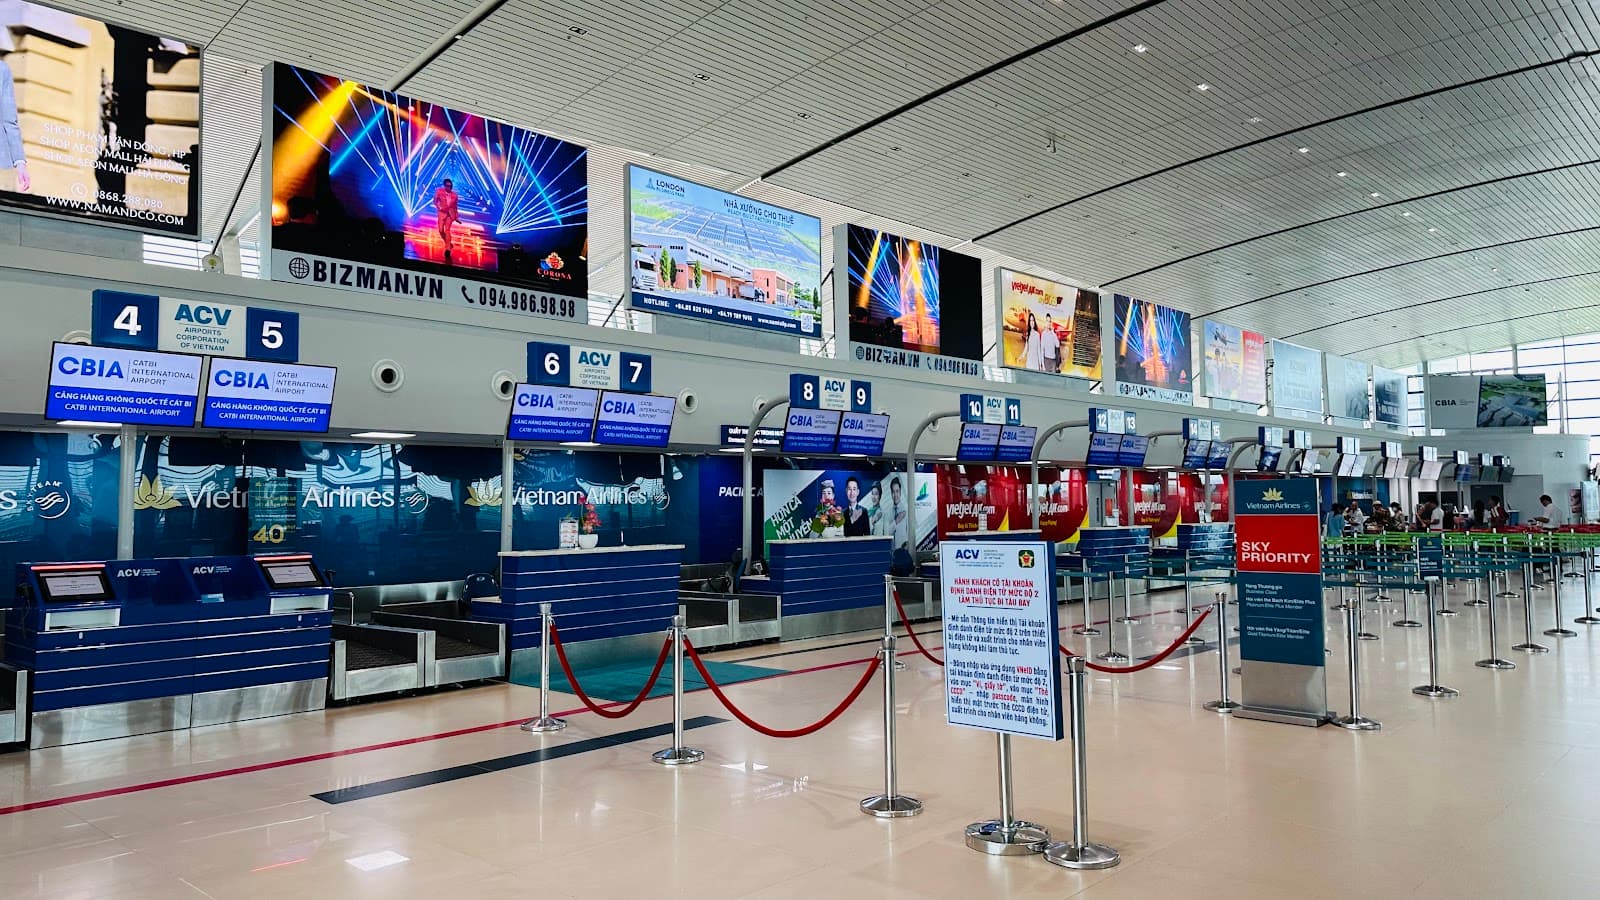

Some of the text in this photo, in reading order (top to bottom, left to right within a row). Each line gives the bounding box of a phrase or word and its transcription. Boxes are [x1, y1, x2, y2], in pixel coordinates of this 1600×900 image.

[74, 143, 103, 157] AEON
[105, 149, 133, 162] MALL
[79, 158, 107, 170] AEON
[656, 180, 685, 193] LONDON
[45, 196, 184, 226] WWW.NAMANDCO.COM
[724, 198, 738, 209] NHÀ
[764, 210, 776, 220] CHO
[537, 268, 572, 280] CORONA
[313, 260, 575, 318] BIZMAN.VN 094.986.98.98
[174, 303, 232, 325] ACV
[113, 305, 142, 336] 4
[184, 327, 222, 336] AIRPORTS
[261, 320, 283, 349] 5
[176, 333, 229, 344] CORPORATION
[192, 343, 225, 351] VIETNAM
[132, 359, 157, 367] CATBI
[544, 352, 560, 375] 6
[578, 351, 611, 366] ACV
[58, 356, 124, 379] CBIA
[131, 368, 195, 379] INTERNATIONAL
[629, 361, 643, 383] 7
[130, 377, 167, 385] AIRPORT
[214, 369, 269, 389] CBIA
[276, 380, 329, 389] INTERNATIONAL
[803, 382, 814, 400] 8
[824, 380, 845, 392] ACV
[80, 391, 104, 401] HÀNG
[105, 394, 134, 403] KHÔNG
[518, 393, 554, 408] CBIA
[856, 388, 866, 405] 9
[232, 402, 252, 410] HÀNG
[253, 404, 277, 412] KHÔNG
[603, 401, 635, 415] CBIA
[969, 401, 981, 417] 10
[987, 398, 1002, 408] ACV
[88, 404, 148, 415] INTERNATIONAL
[149, 408, 180, 417] AIRPORT
[1009, 404, 1018, 420] 11
[239, 413, 289, 422] INTERNATIONAL
[790, 415, 812, 427] CBIA
[1097, 413, 1106, 427] 12
[1126, 416, 1136, 430] 13
[843, 418, 864, 430] CBIA
[964, 429, 980, 439] CBIA
[1002, 431, 1017, 441] CBIA
[302, 486, 395, 508] Airlines
[585, 486, 647, 505] Airlines
[1246, 502, 1274, 510] Vietnam
[1241, 541, 1271, 552] SKY
[955, 549, 979, 559] ACV
[1241, 552, 1311, 564] PRIORITY
[117, 569, 140, 577] ACV
[193, 566, 214, 574] ACV
[1034, 590, 1039, 598] 2
